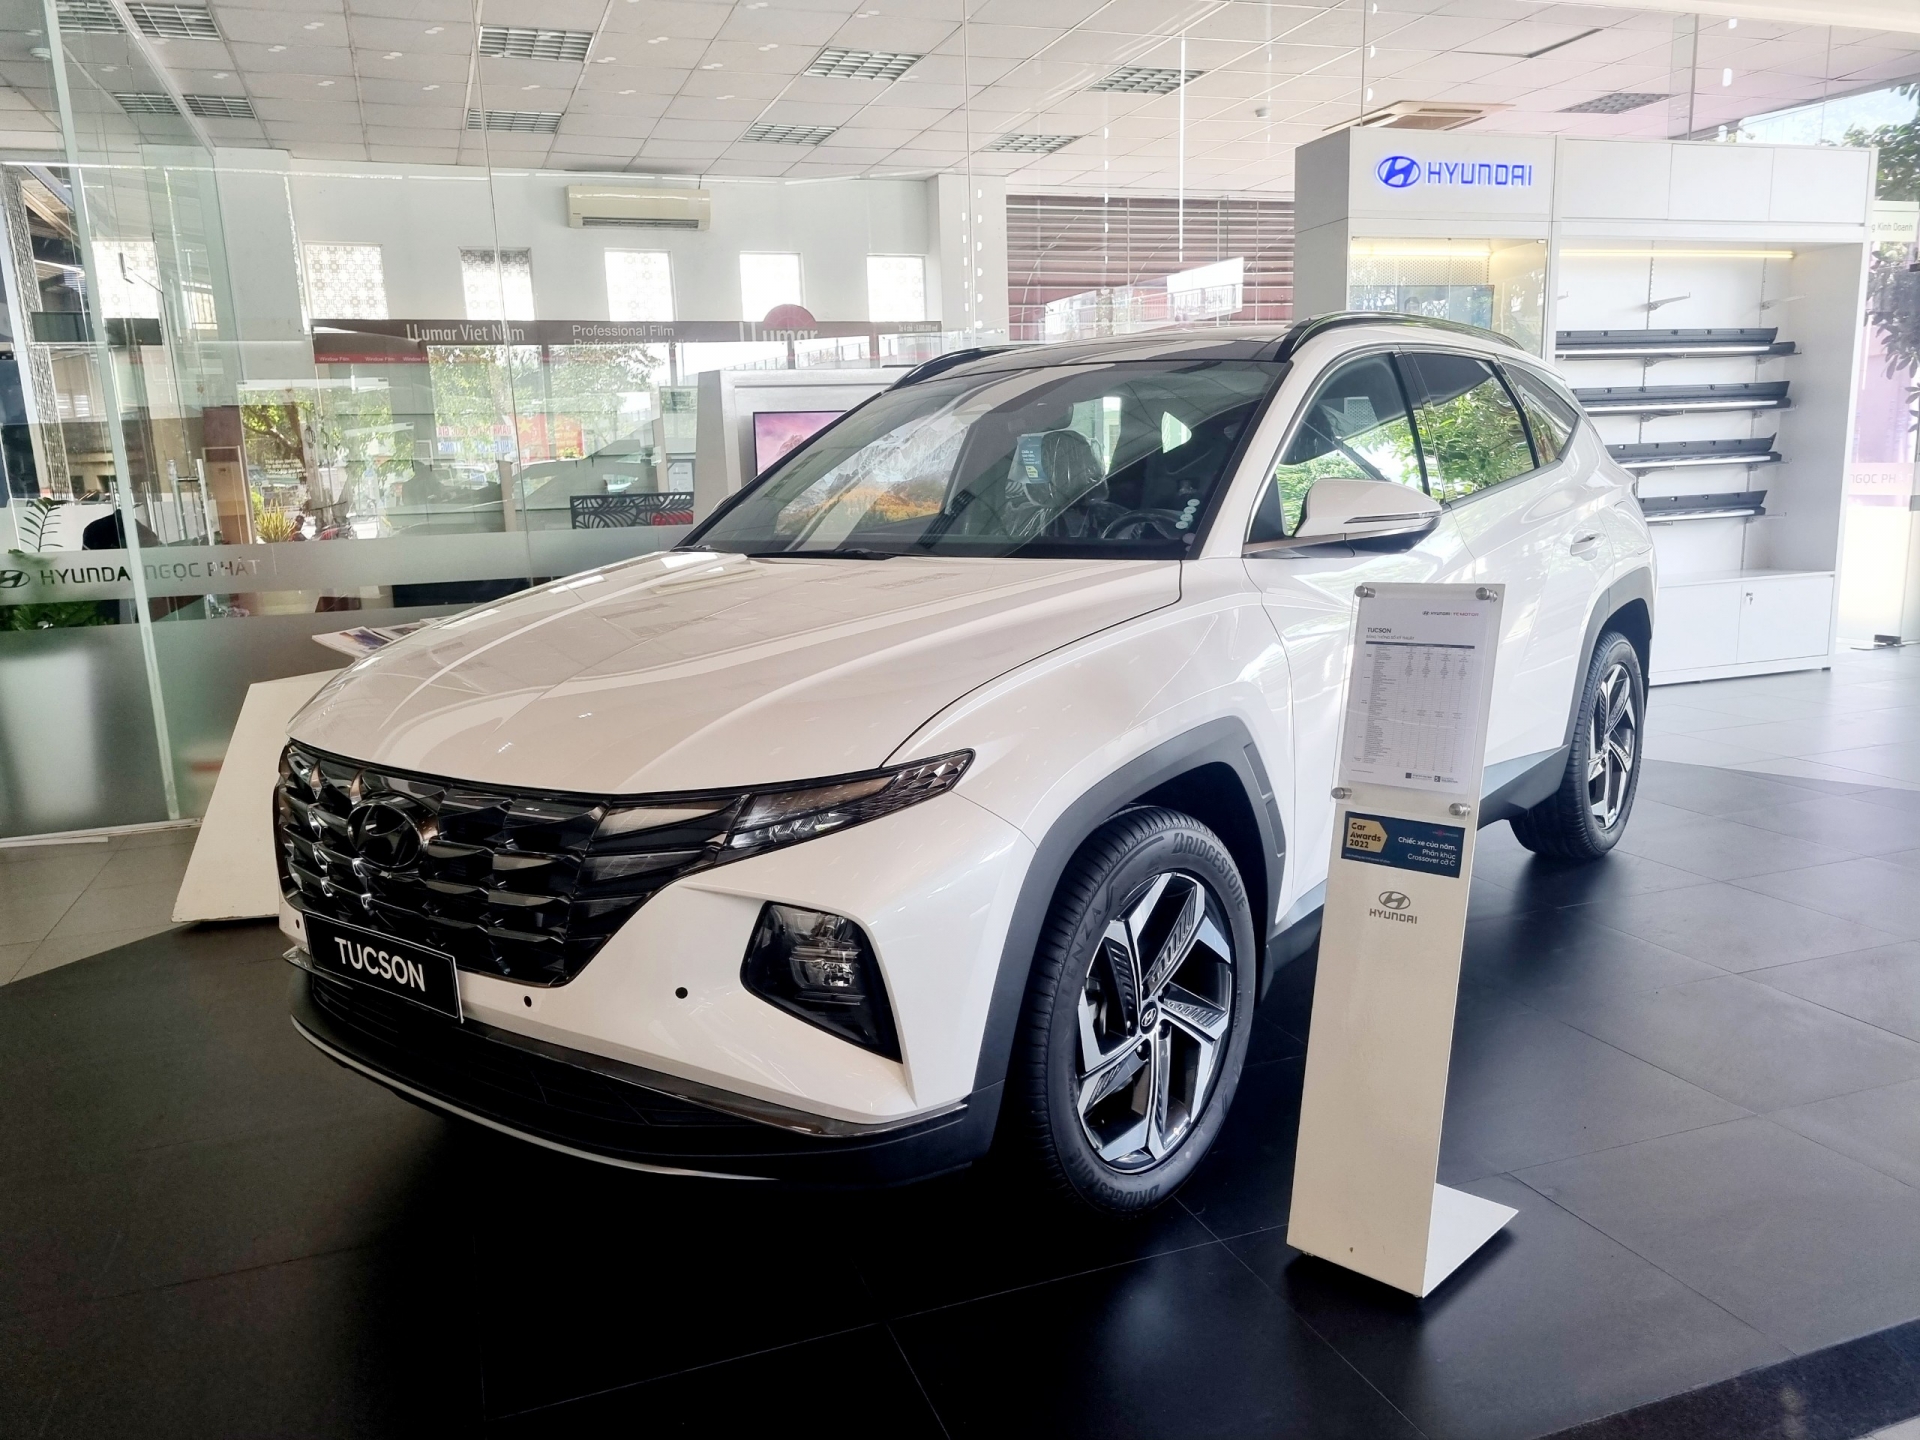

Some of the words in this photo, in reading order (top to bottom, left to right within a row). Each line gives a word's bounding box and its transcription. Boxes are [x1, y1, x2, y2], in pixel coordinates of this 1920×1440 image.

[1426, 161, 1532, 186] HYUNDAI
[1877, 222, 1891, 231] Kinh
[1893, 222, 1913, 232] Doanh
[460, 323, 488, 341] Viet
[572, 324, 646, 337] Professional
[650, 325, 675, 337] Film
[41, 566, 131, 585] HYUNDA
[1351, 822, 1367, 831] Car
[1350, 831, 1382, 843] Awards
[1397, 836, 1416, 845] Chiếc
[1426, 840, 1439, 849] của
[1349, 839, 1369, 849] 2022
[1407, 853, 1439, 864] Crossover
[1422, 848, 1439, 857] Phân
[1440, 850, 1456, 860] khúc
[1171, 832, 1247, 911] BRIDGESTONE
[1369, 908, 1418, 924] HYUNDAI
[334, 937, 426, 992] TUCSON
